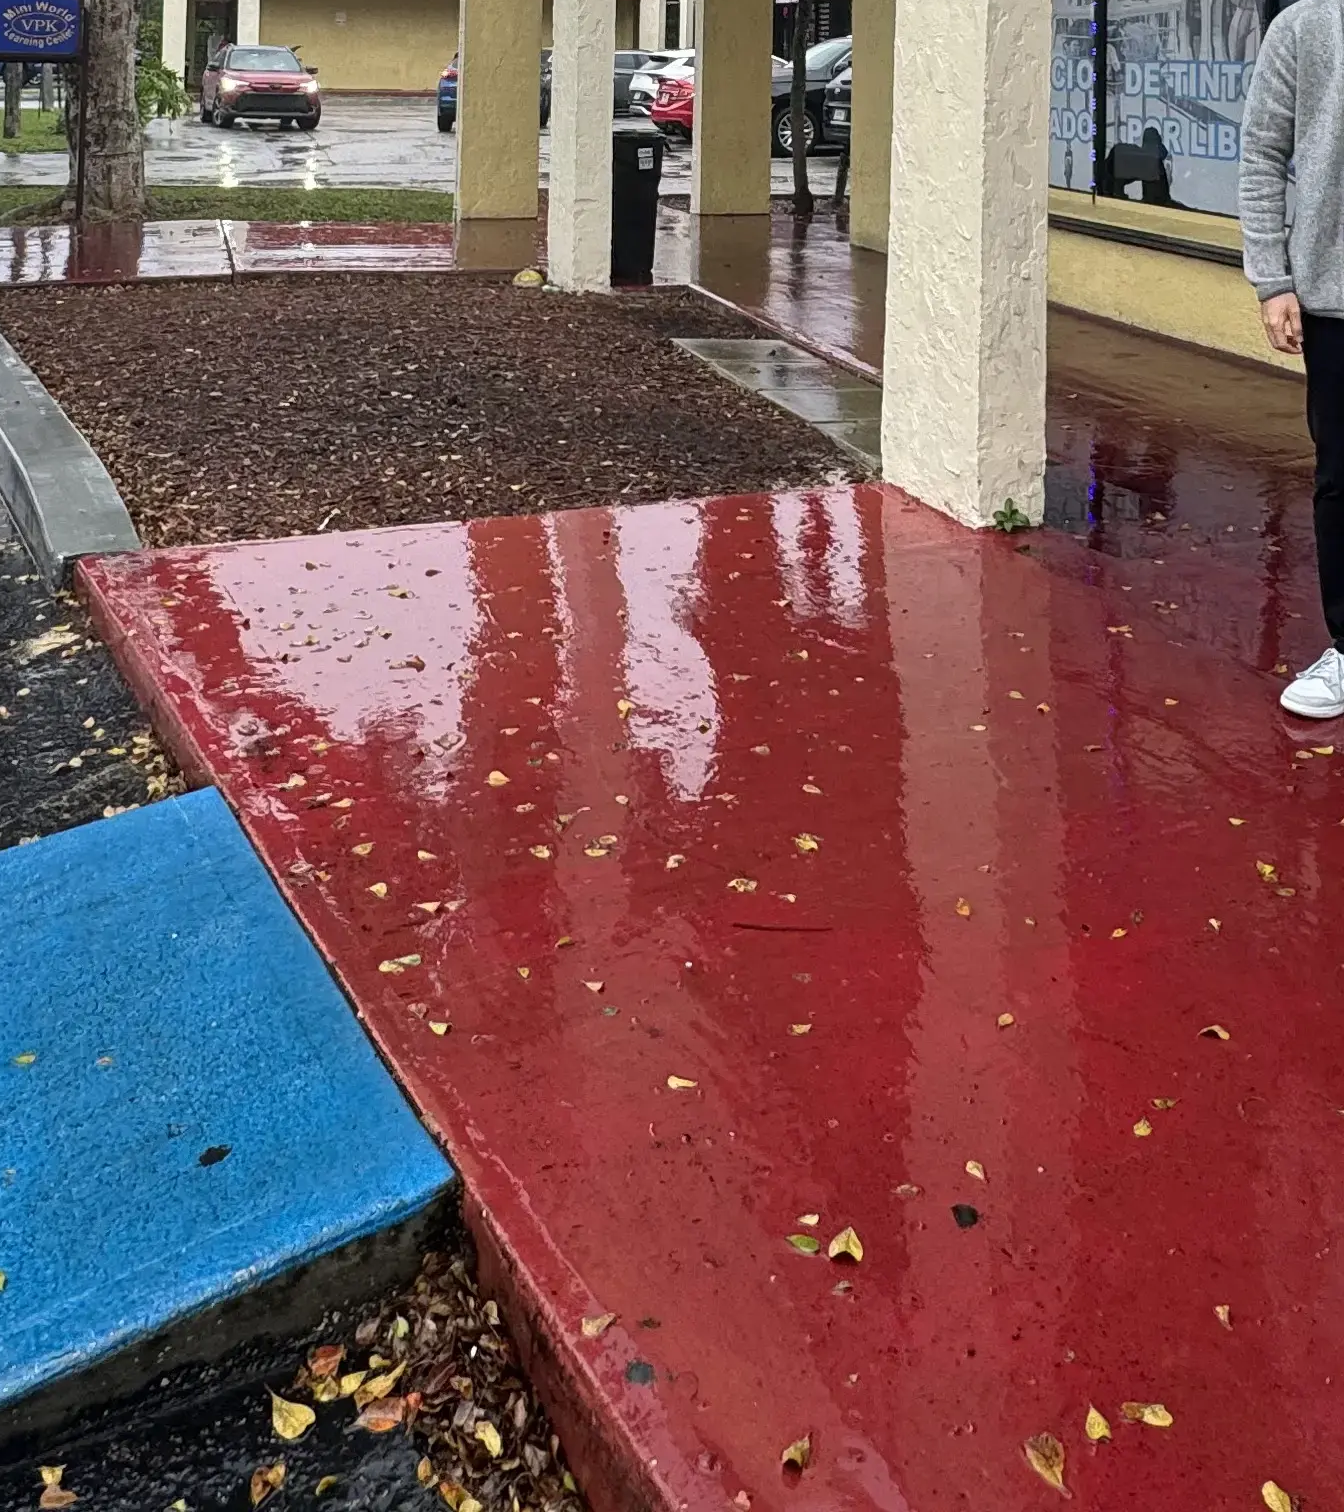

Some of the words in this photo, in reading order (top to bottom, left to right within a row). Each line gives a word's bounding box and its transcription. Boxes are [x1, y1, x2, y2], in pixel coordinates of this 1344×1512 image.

[2, 4, 32, 21] Mini
[36, 1, 76, 22] World
[21, 19, 58, 32] VPK
[4, 28, 45, 48] Learning
[1124, 60, 1162, 98] DE
[1189, 120, 1240, 162] LIB
